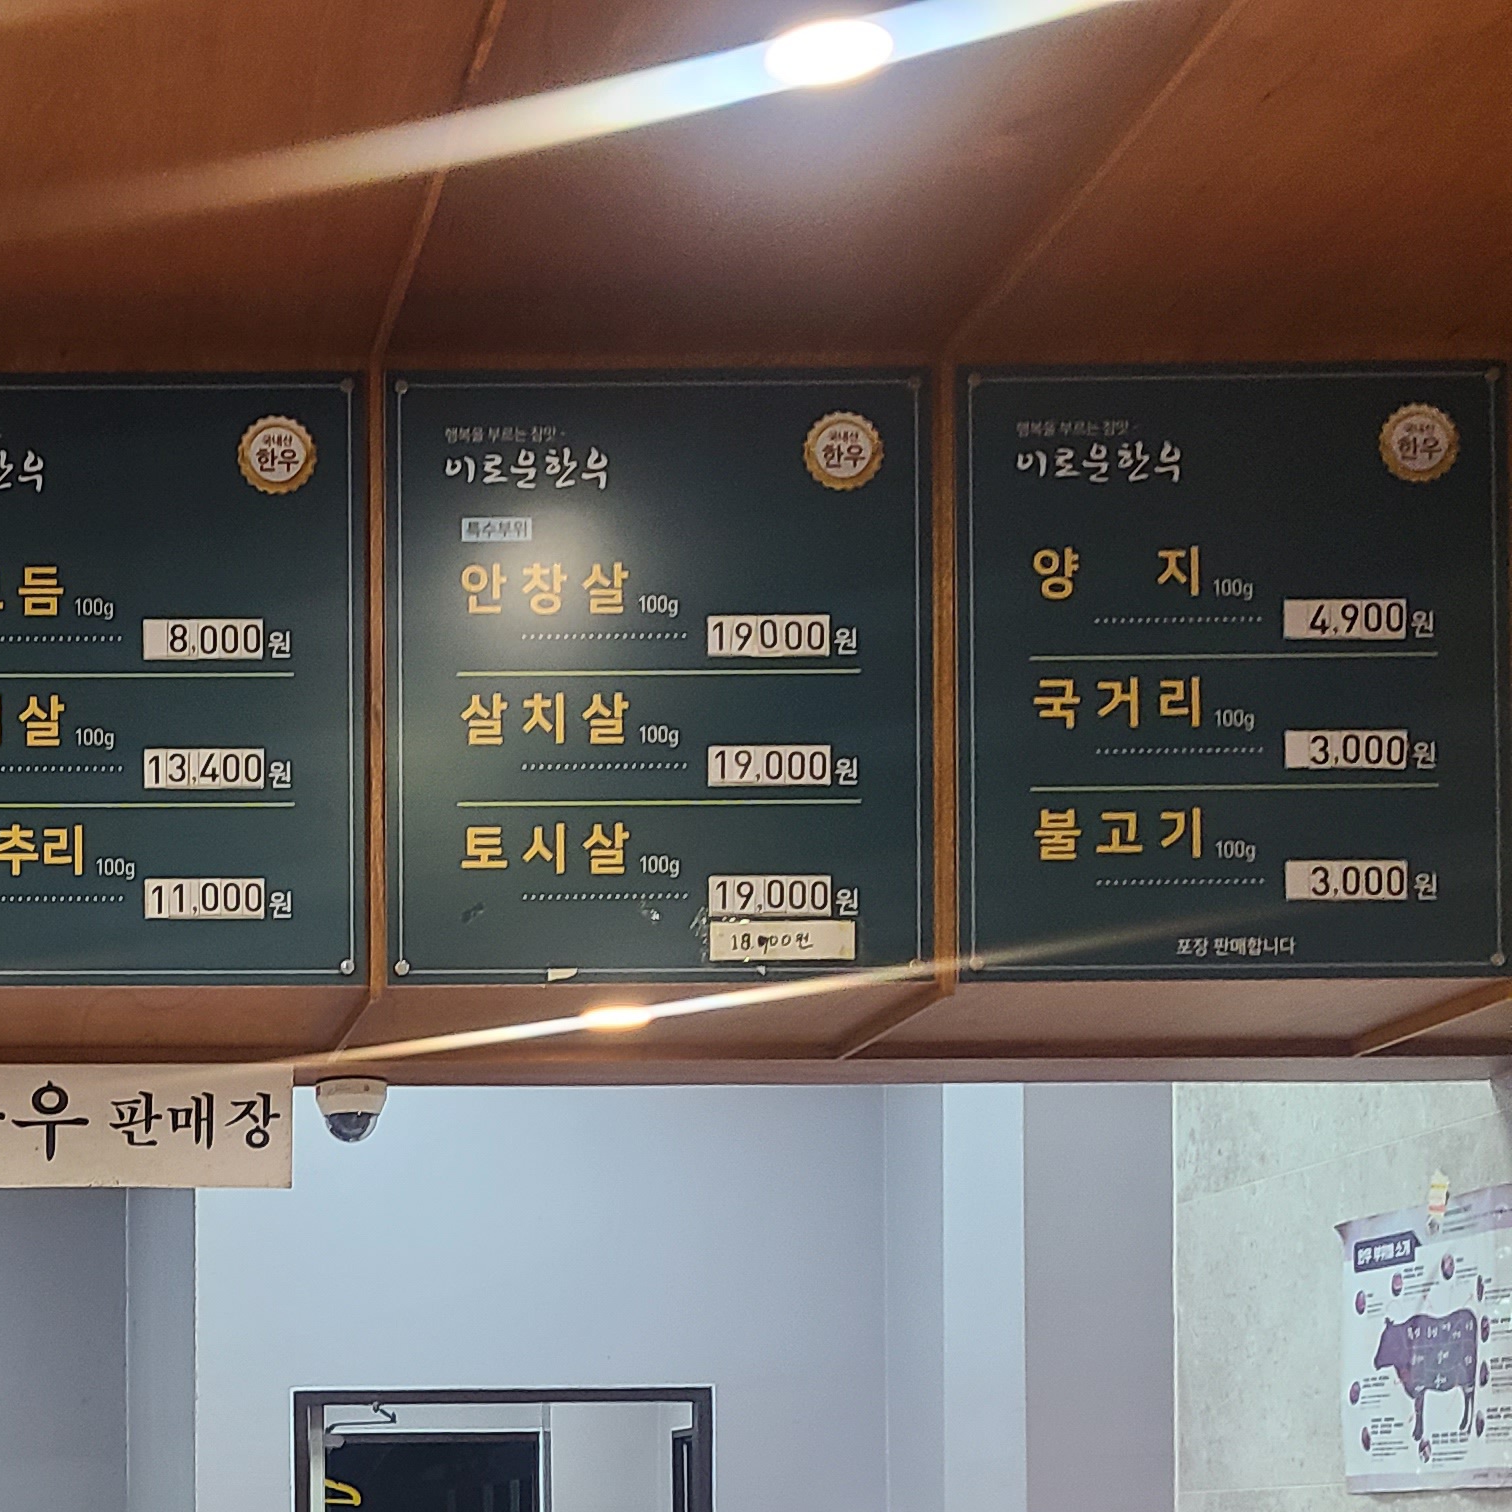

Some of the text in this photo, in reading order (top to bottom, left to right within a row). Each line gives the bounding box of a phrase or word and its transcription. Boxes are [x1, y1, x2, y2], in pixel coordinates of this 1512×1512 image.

[256, 446, 300, 472] 한우
[823, 442, 866, 468] 한우
[1017, 441, 1181, 484] 이로운한우
[1397, 435, 1441, 460] 한우
[445, 447, 608, 490] 이로운한우
[461, 562, 629, 616] 안창살
[638, 595, 679, 617] 100g
[1213, 578, 1254, 600] 100g
[75, 597, 115, 620] 100g
[461, 693, 629, 745] 살치살
[639, 726, 679, 748] 100g
[1033, 677, 1201, 729] 국거리
[1215, 708, 1255, 731] 100g
[75, 728, 115, 751] 100g
[461, 823, 630, 875] 토시살
[640, 855, 680, 878] 100g
[1034, 807, 1203, 861] 불고기
[1215, 840, 1256, 862] 100g
[95, 858, 136, 881] 100g
[1177, 936, 1296, 957] 포장 판매합니다
[109, 1091, 281, 1150] 판매장
